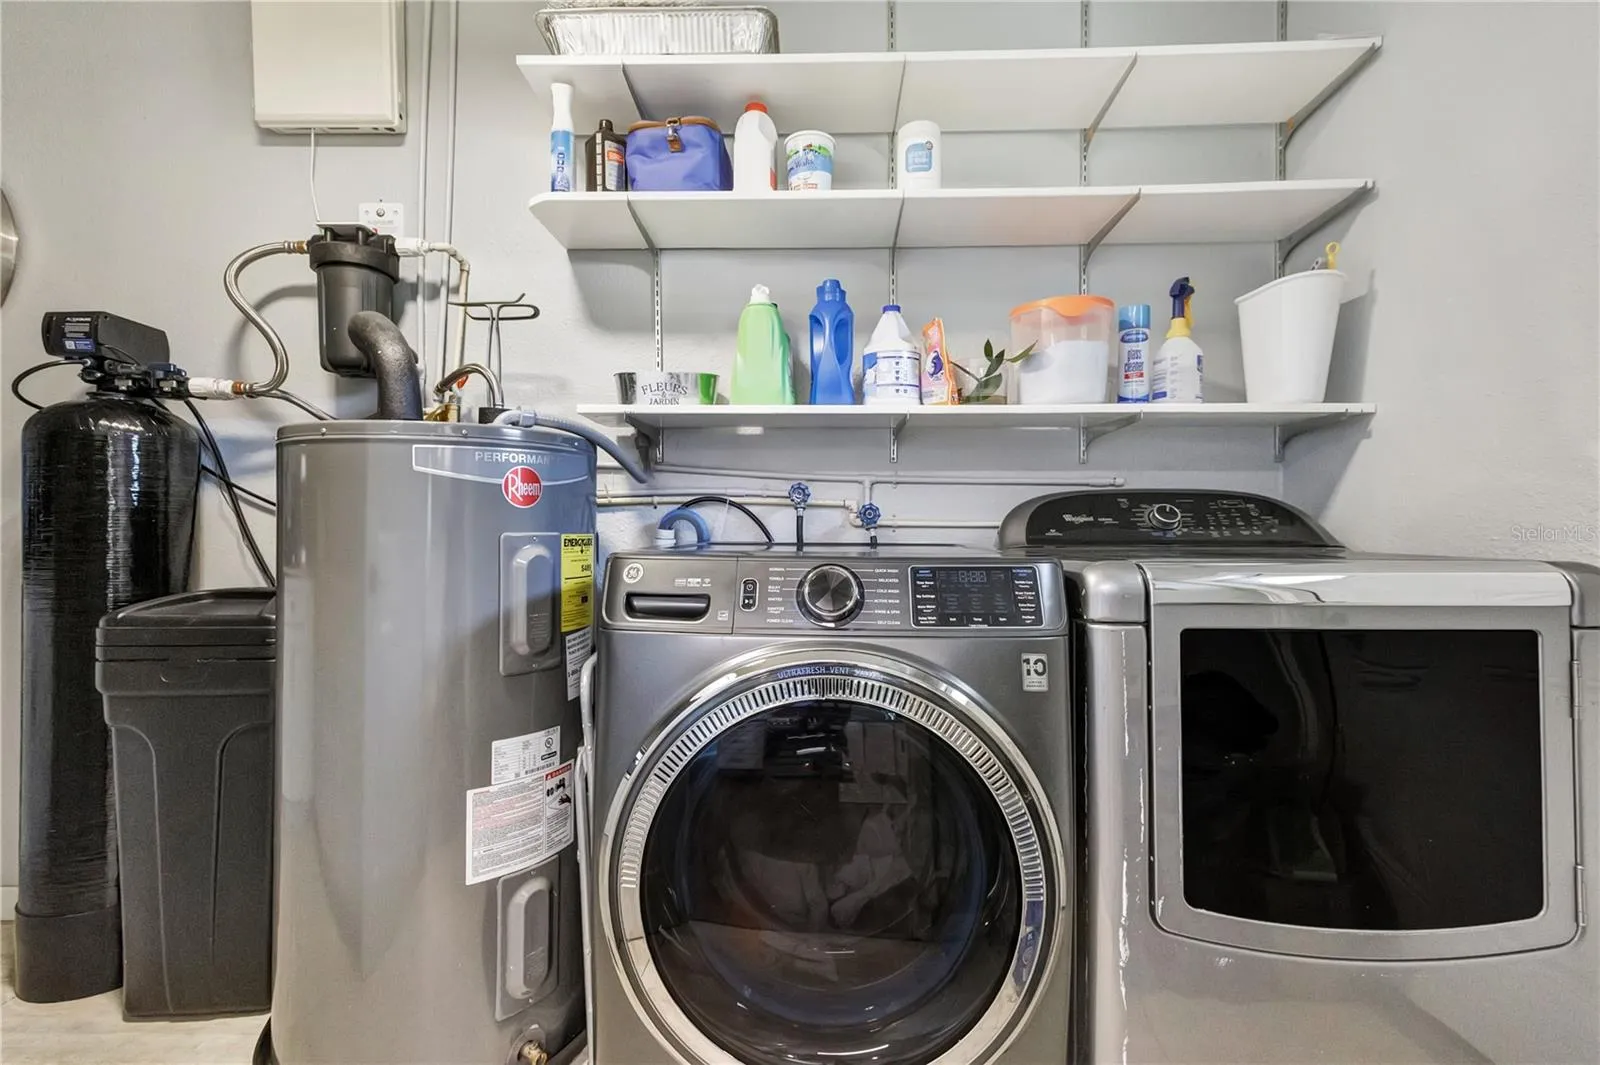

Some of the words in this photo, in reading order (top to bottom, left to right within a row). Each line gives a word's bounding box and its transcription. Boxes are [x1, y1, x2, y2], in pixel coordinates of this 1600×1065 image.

[641, 382, 688, 396] FLEURS
[508, 467, 540, 501] Rheem
[777, 666, 826, 678] ULTRAFRESH
[830, 666, 849, 675] VENT
[1023, 658, 1046, 676] 10
